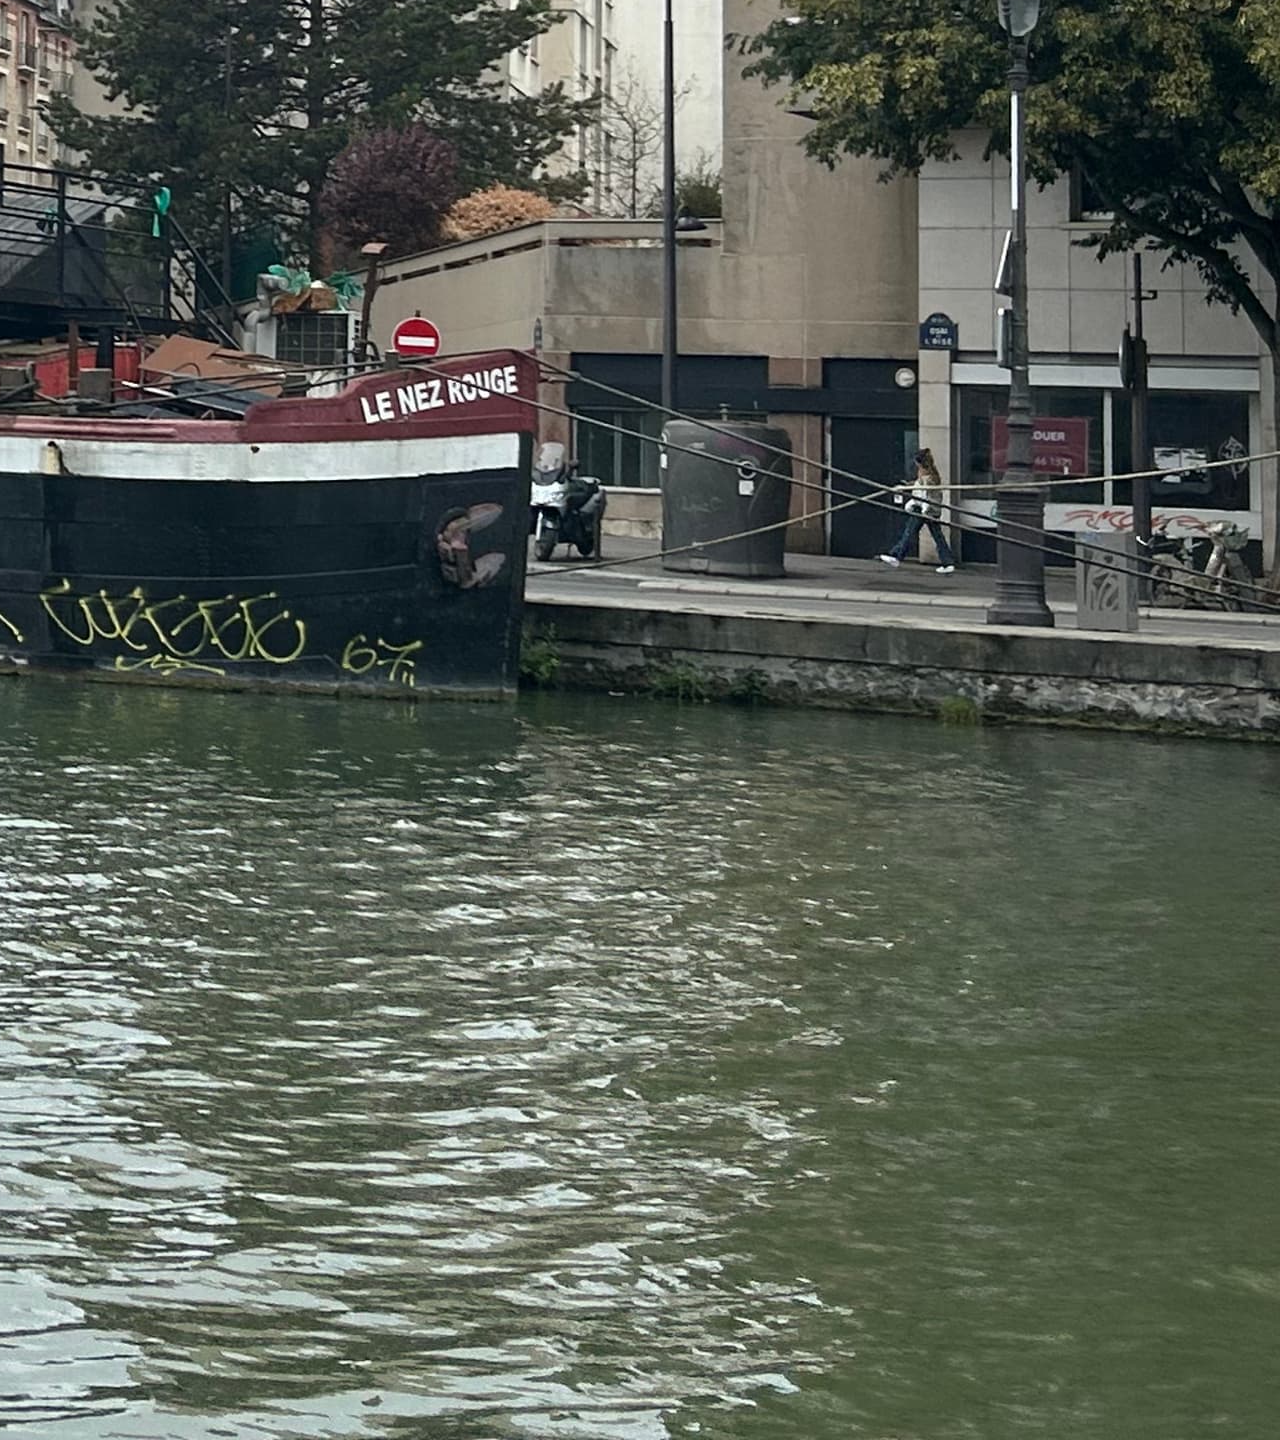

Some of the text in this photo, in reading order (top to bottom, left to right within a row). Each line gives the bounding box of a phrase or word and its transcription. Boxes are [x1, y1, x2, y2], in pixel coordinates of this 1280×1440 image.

[361, 365, 519, 424] LE NEZ ROUGE
[1031, 431, 1065, 441] OUER
